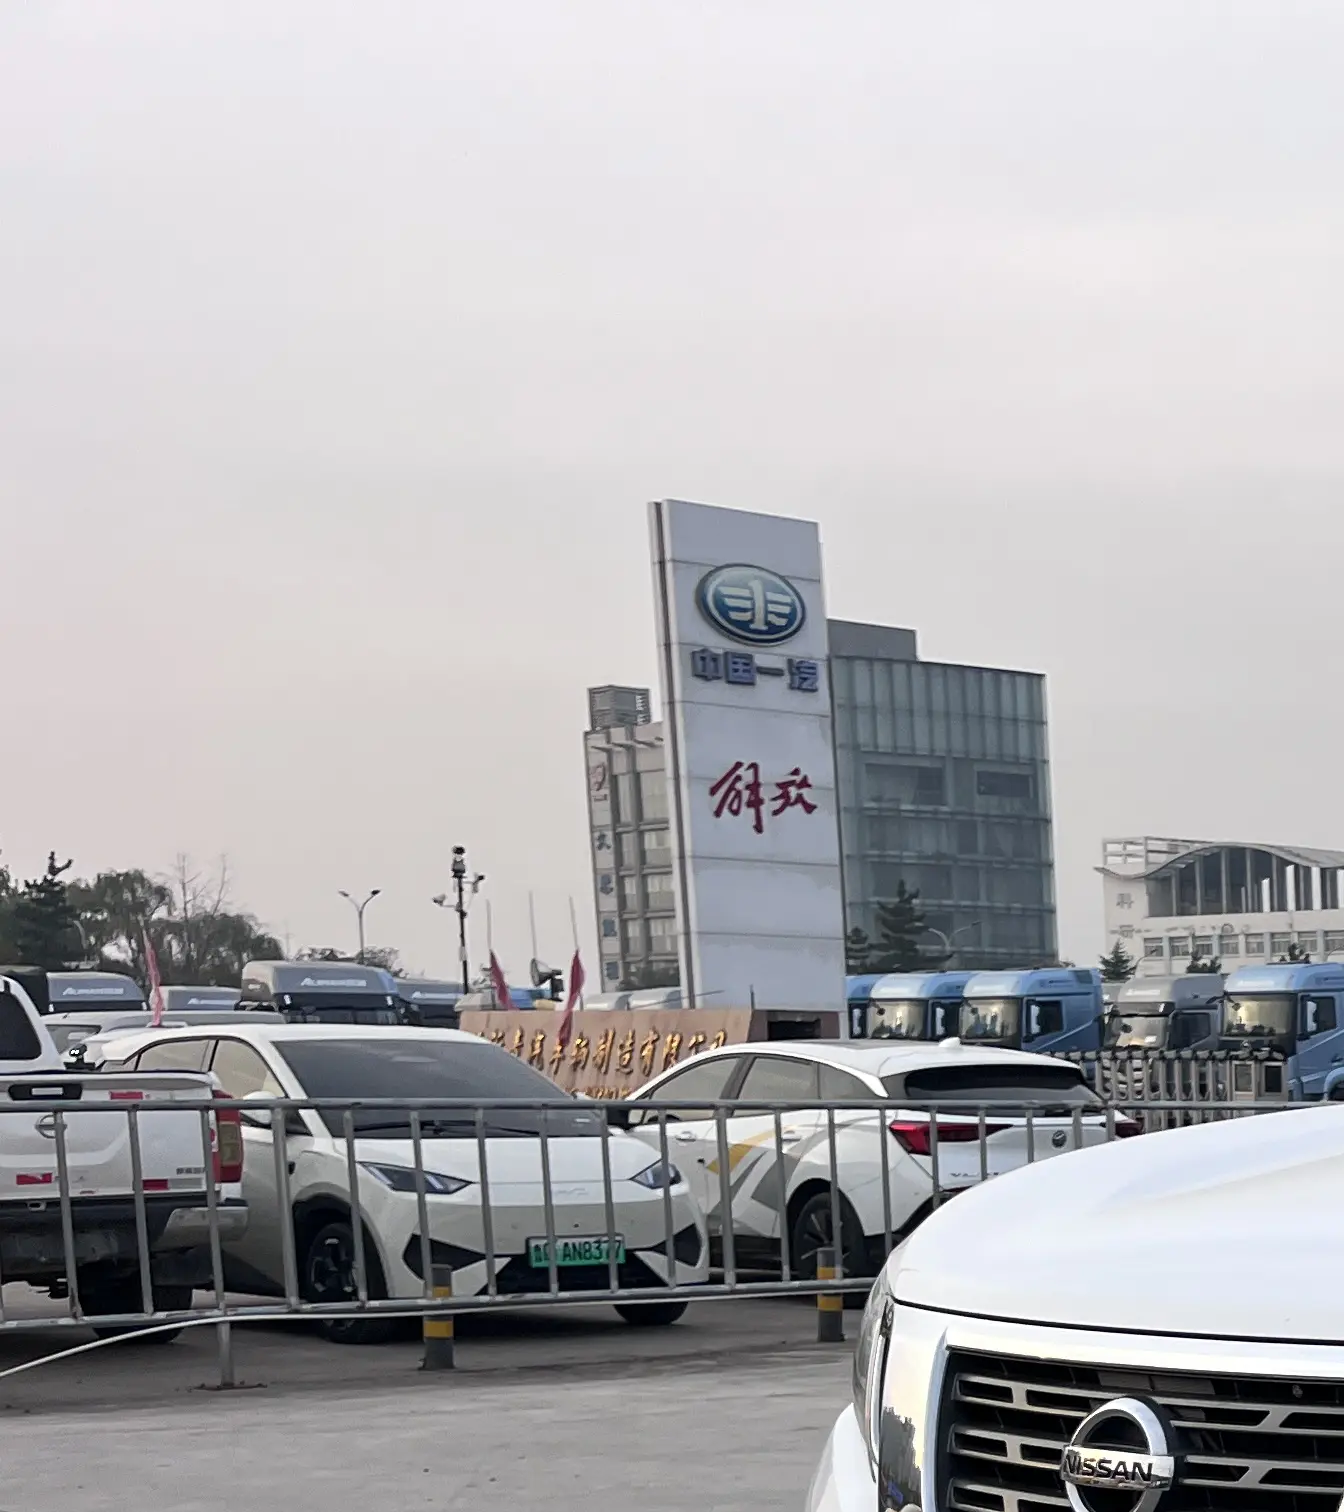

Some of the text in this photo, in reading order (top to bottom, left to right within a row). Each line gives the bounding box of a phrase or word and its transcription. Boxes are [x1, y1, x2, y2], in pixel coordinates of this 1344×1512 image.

[691, 648, 819, 692] 中国一汽
[1065, 1450, 1154, 1482] NISSAN
